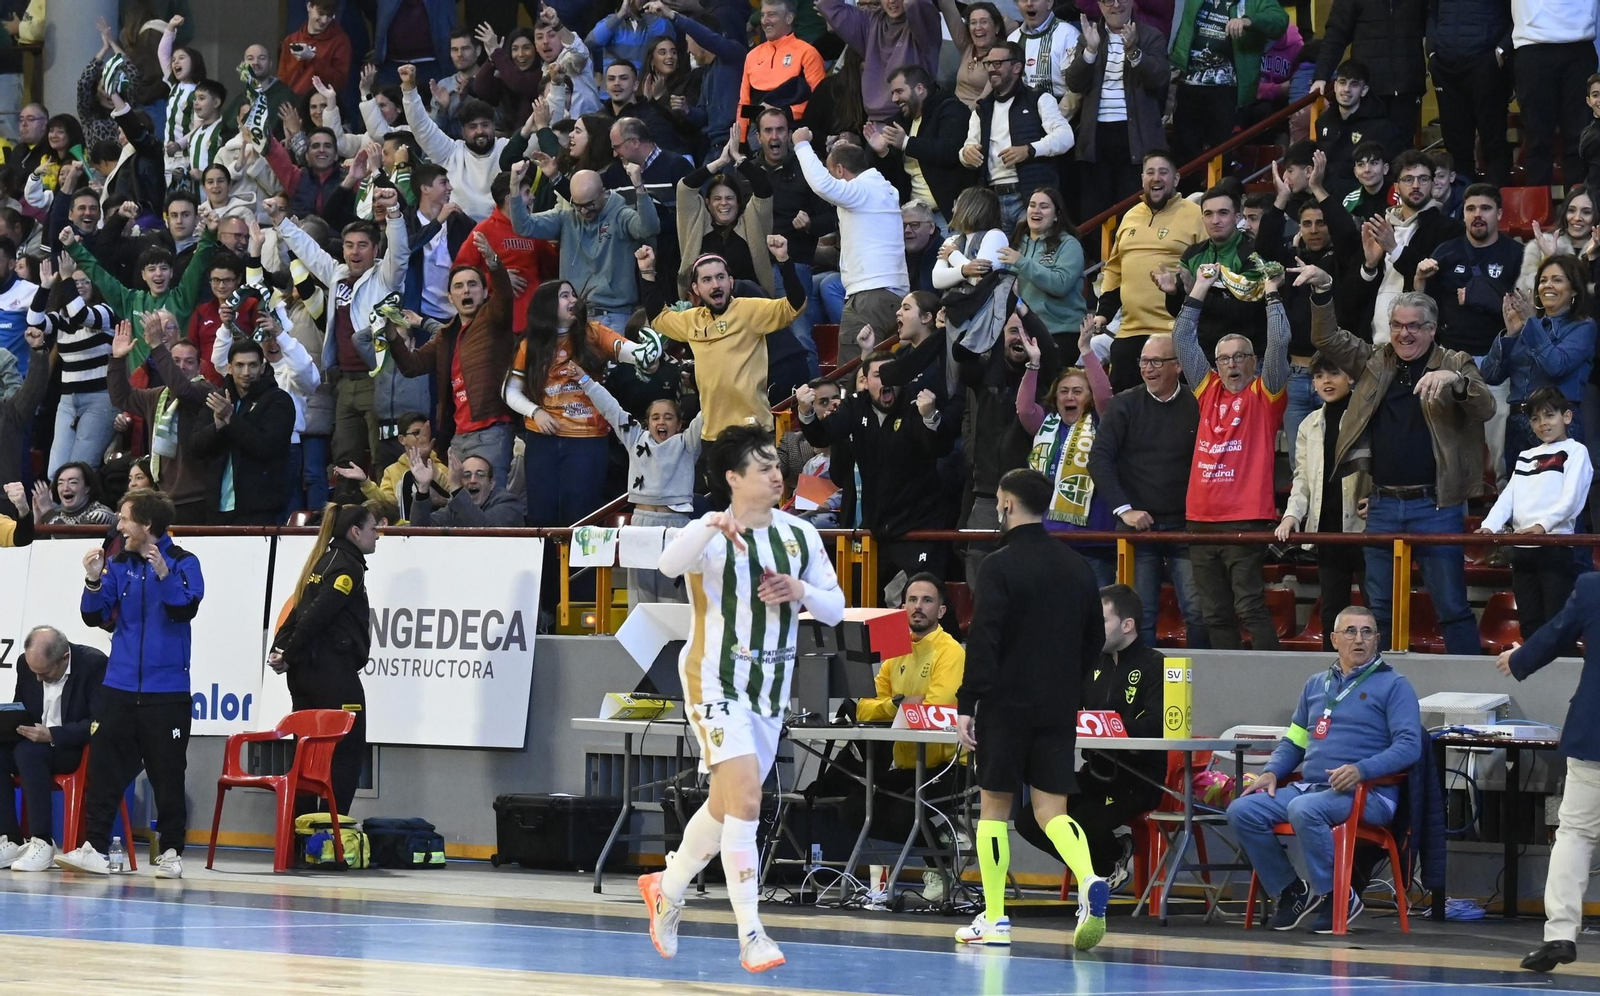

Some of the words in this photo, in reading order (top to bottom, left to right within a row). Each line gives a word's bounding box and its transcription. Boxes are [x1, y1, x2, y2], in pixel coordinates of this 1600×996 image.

[369, 607, 527, 652] NGEDECA
[358, 657, 494, 679] ONSTRUCTORA
[1167, 670, 1181, 679] SV
